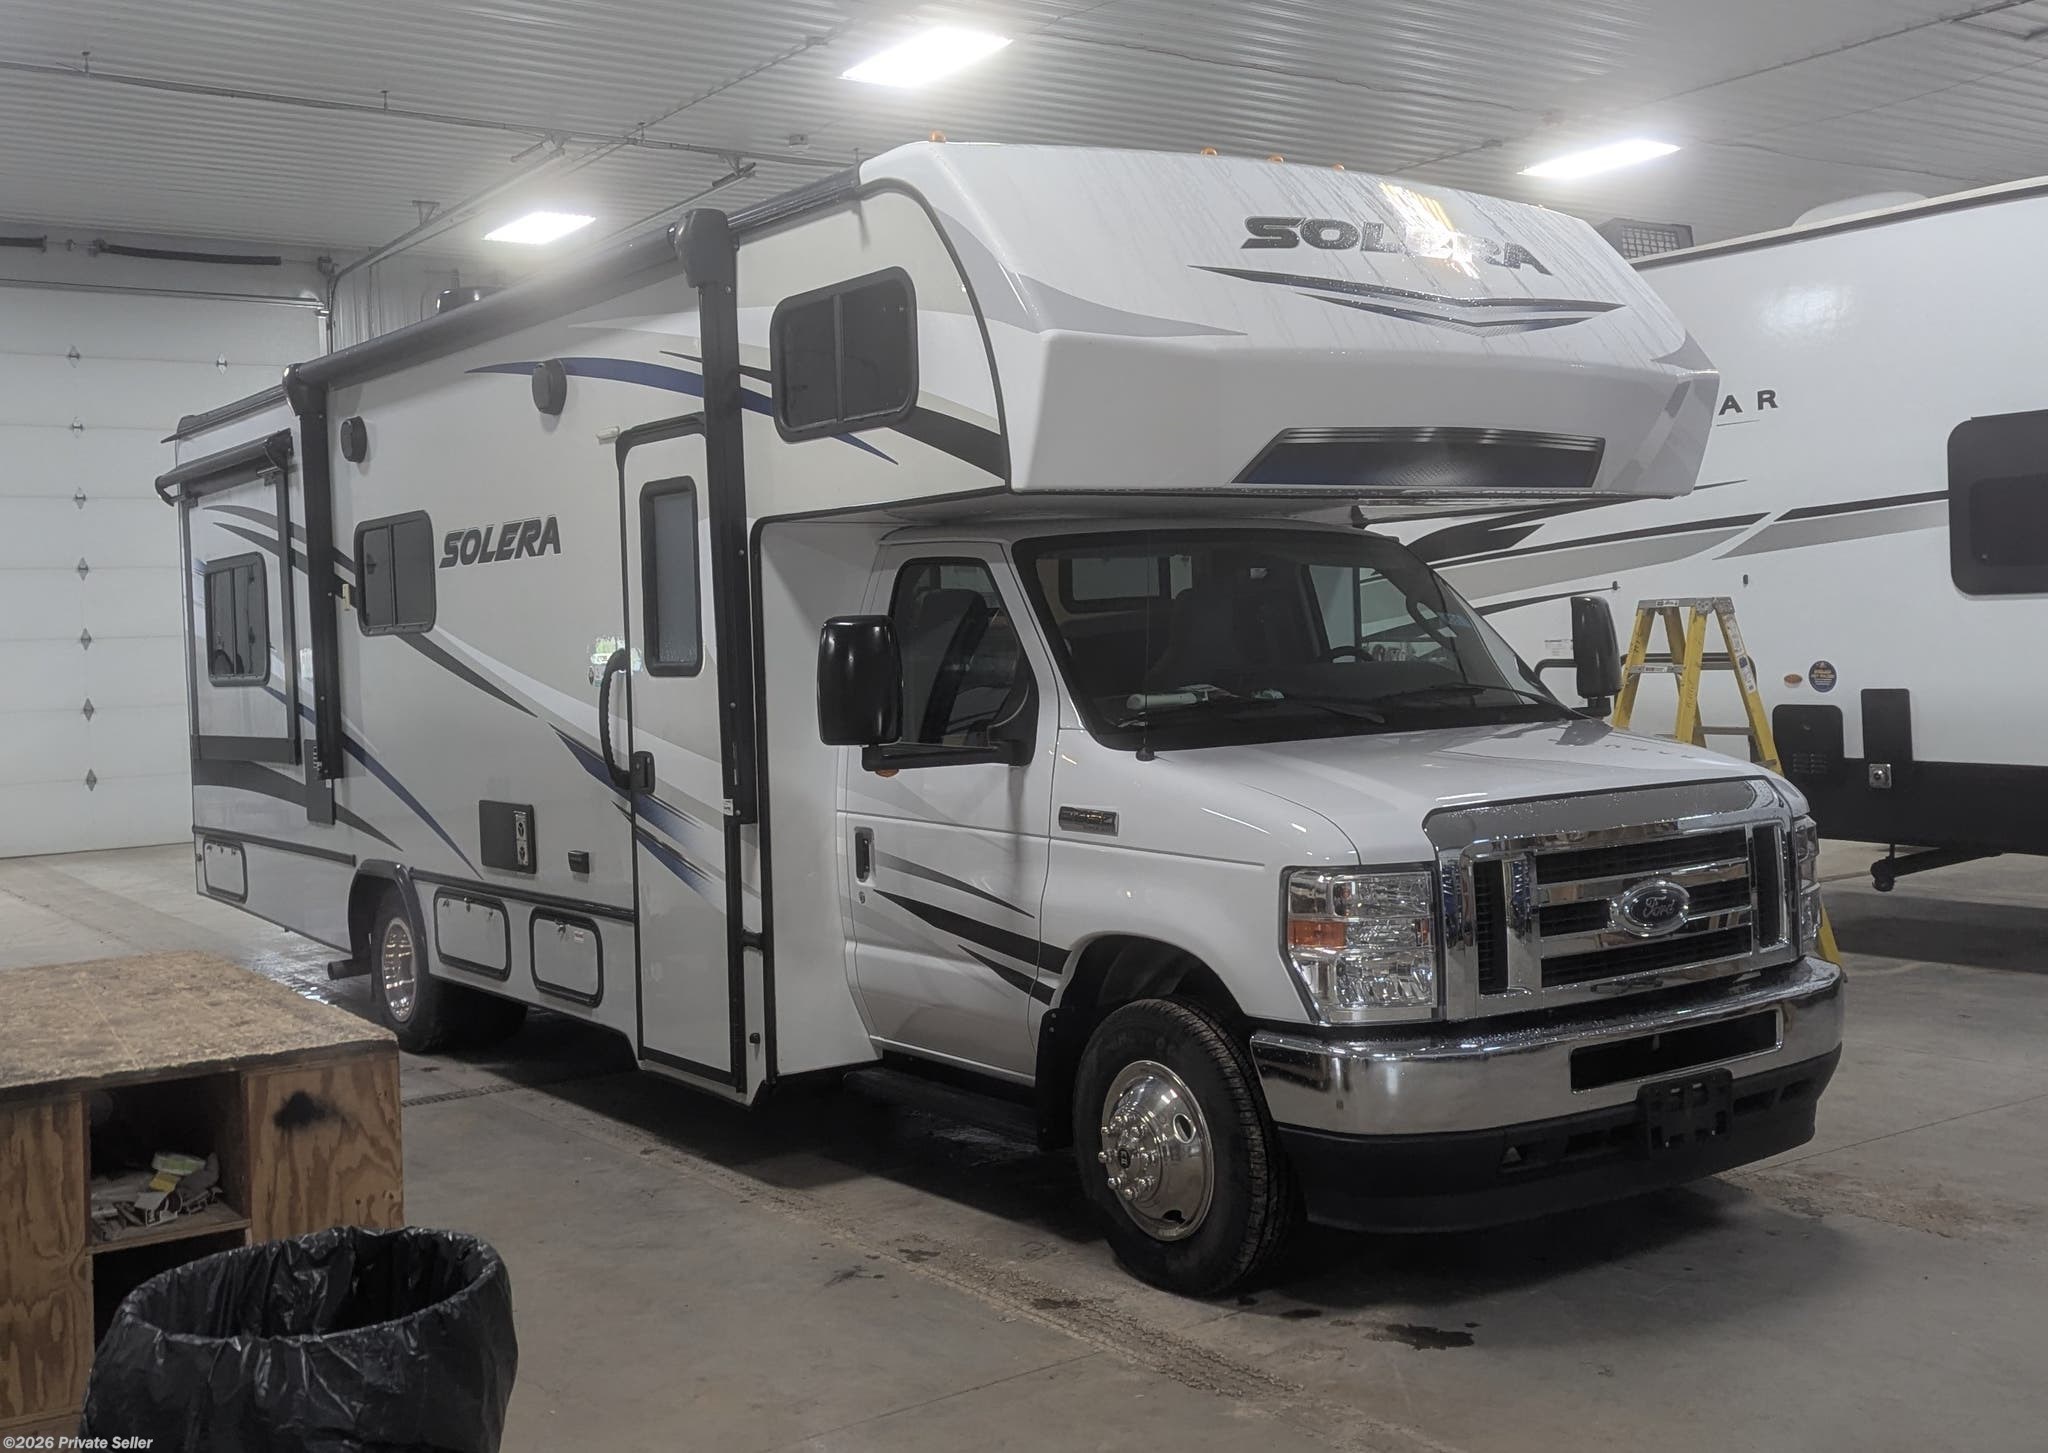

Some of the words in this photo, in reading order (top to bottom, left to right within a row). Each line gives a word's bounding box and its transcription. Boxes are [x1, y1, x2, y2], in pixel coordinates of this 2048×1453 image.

[1240, 215, 1553, 277] SOLRA
[1718, 389, 1779, 416] AR
[438, 515, 562, 569] SOLERA
[1642, 895, 1677, 918] Ford
